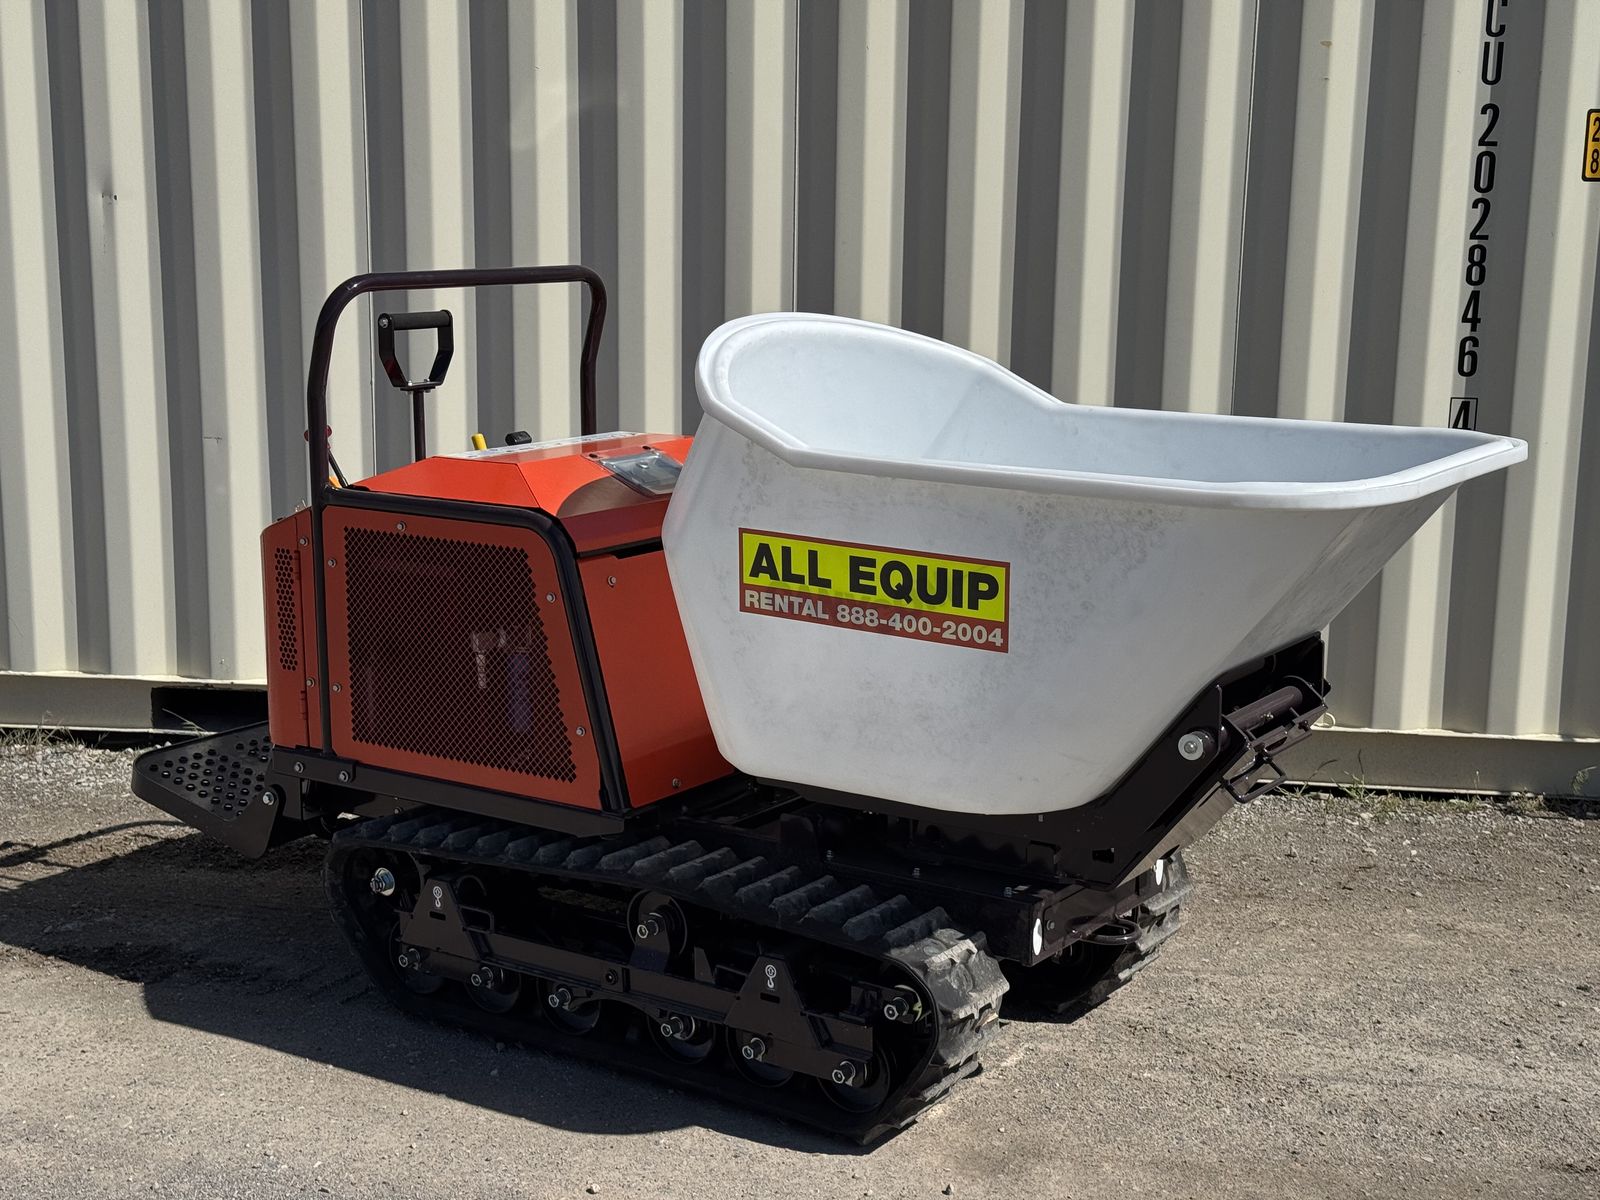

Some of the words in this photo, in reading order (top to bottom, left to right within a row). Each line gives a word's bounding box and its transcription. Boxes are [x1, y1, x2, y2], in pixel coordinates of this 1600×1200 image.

[1457, 103, 1500, 377] 202846
[1452, 401, 1472, 430] 4
[749, 542, 832, 589] ALL
[849, 555, 1000, 610] EQUIP
[744, 590, 829, 619] RENTAL
[836, 604, 1004, 647] 888-400-2004
